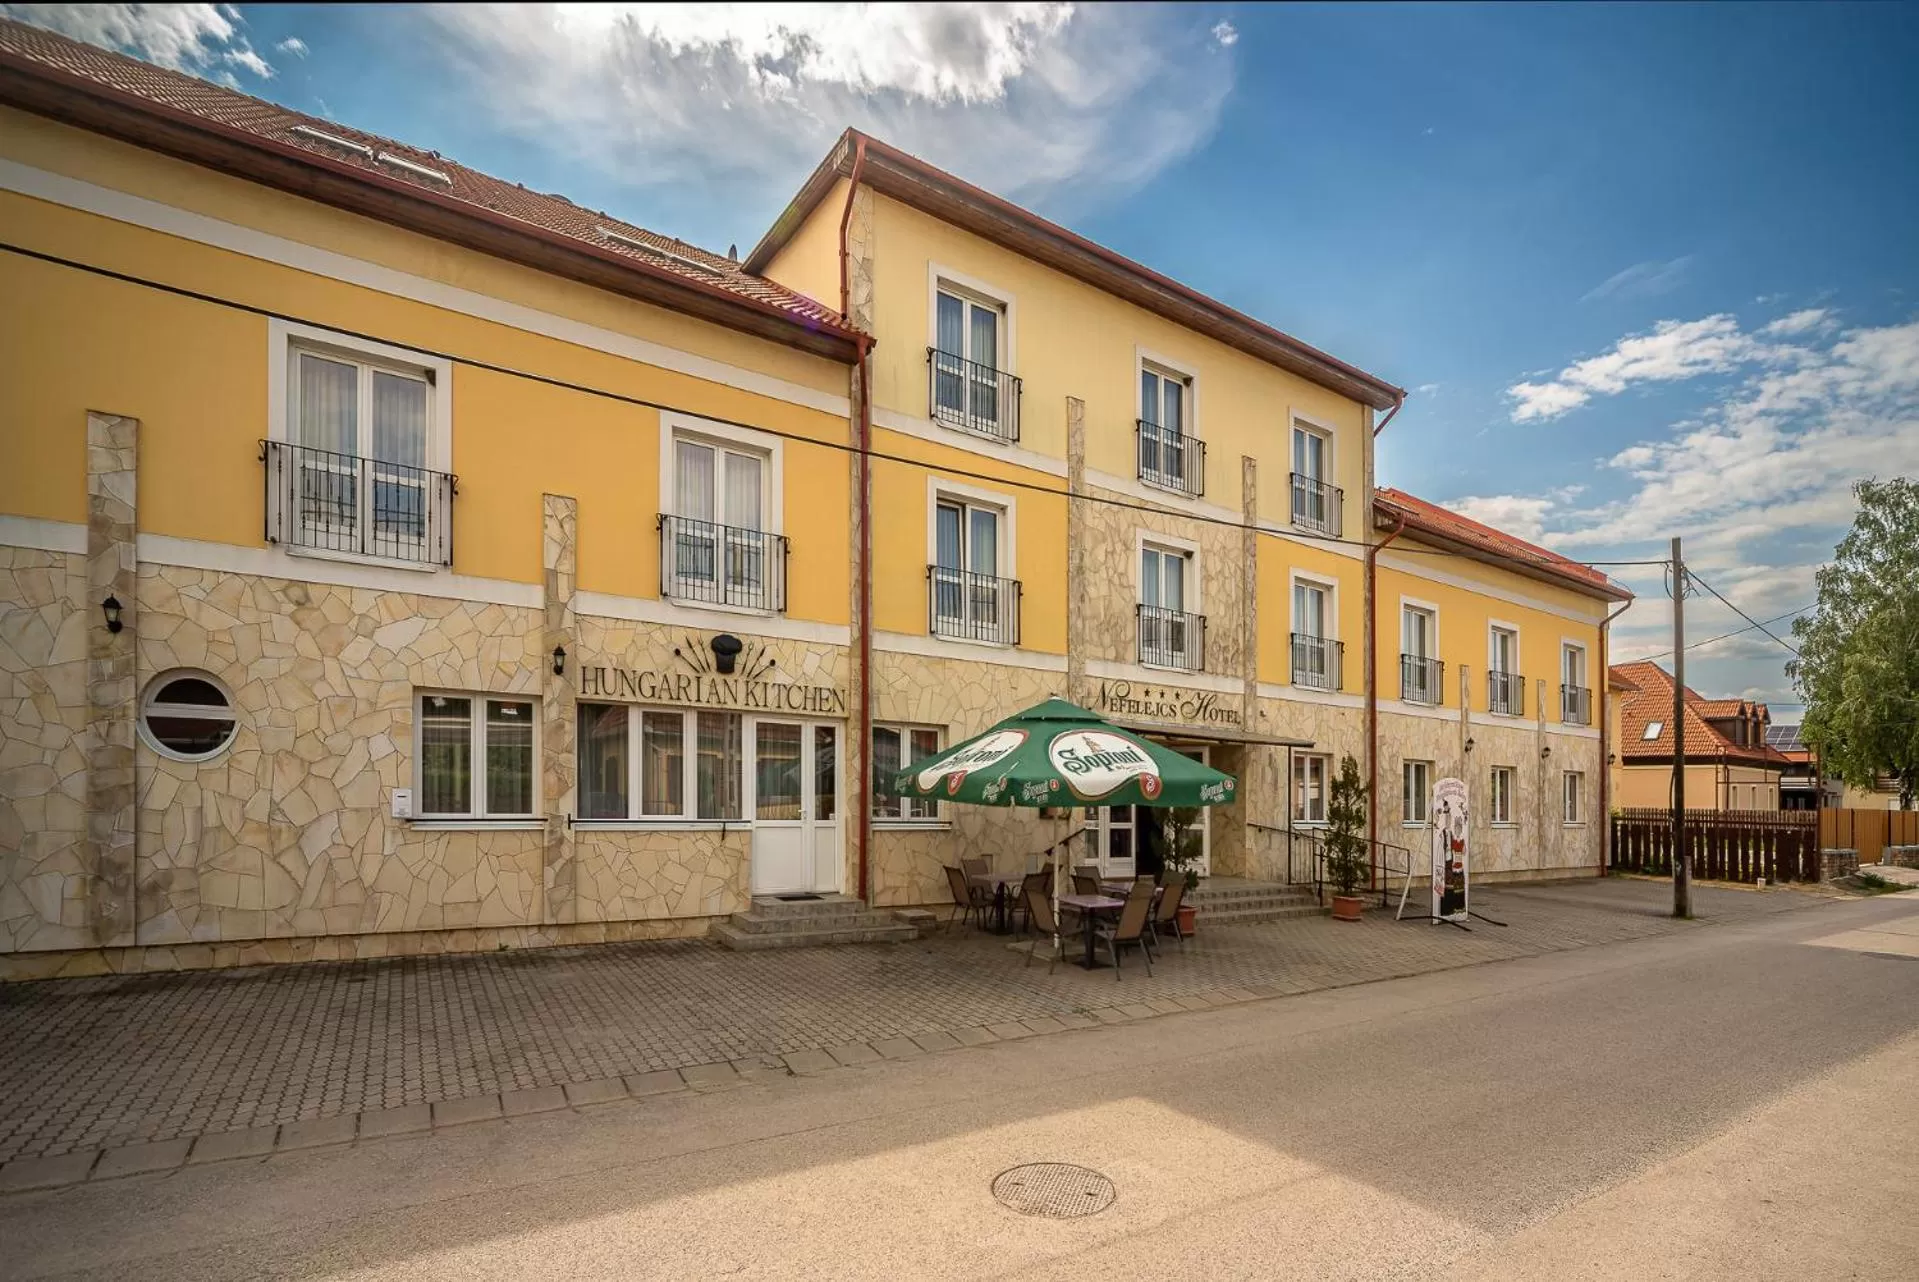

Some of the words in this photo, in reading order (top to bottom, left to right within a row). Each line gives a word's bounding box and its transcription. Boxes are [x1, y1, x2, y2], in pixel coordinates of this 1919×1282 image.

[581, 666, 738, 704] HUNGARIAN
[745, 680, 846, 712] KITCHEN
[1090, 679, 1177, 717] NEFELEJCS
[1181, 692, 1241, 724] HOTEL
